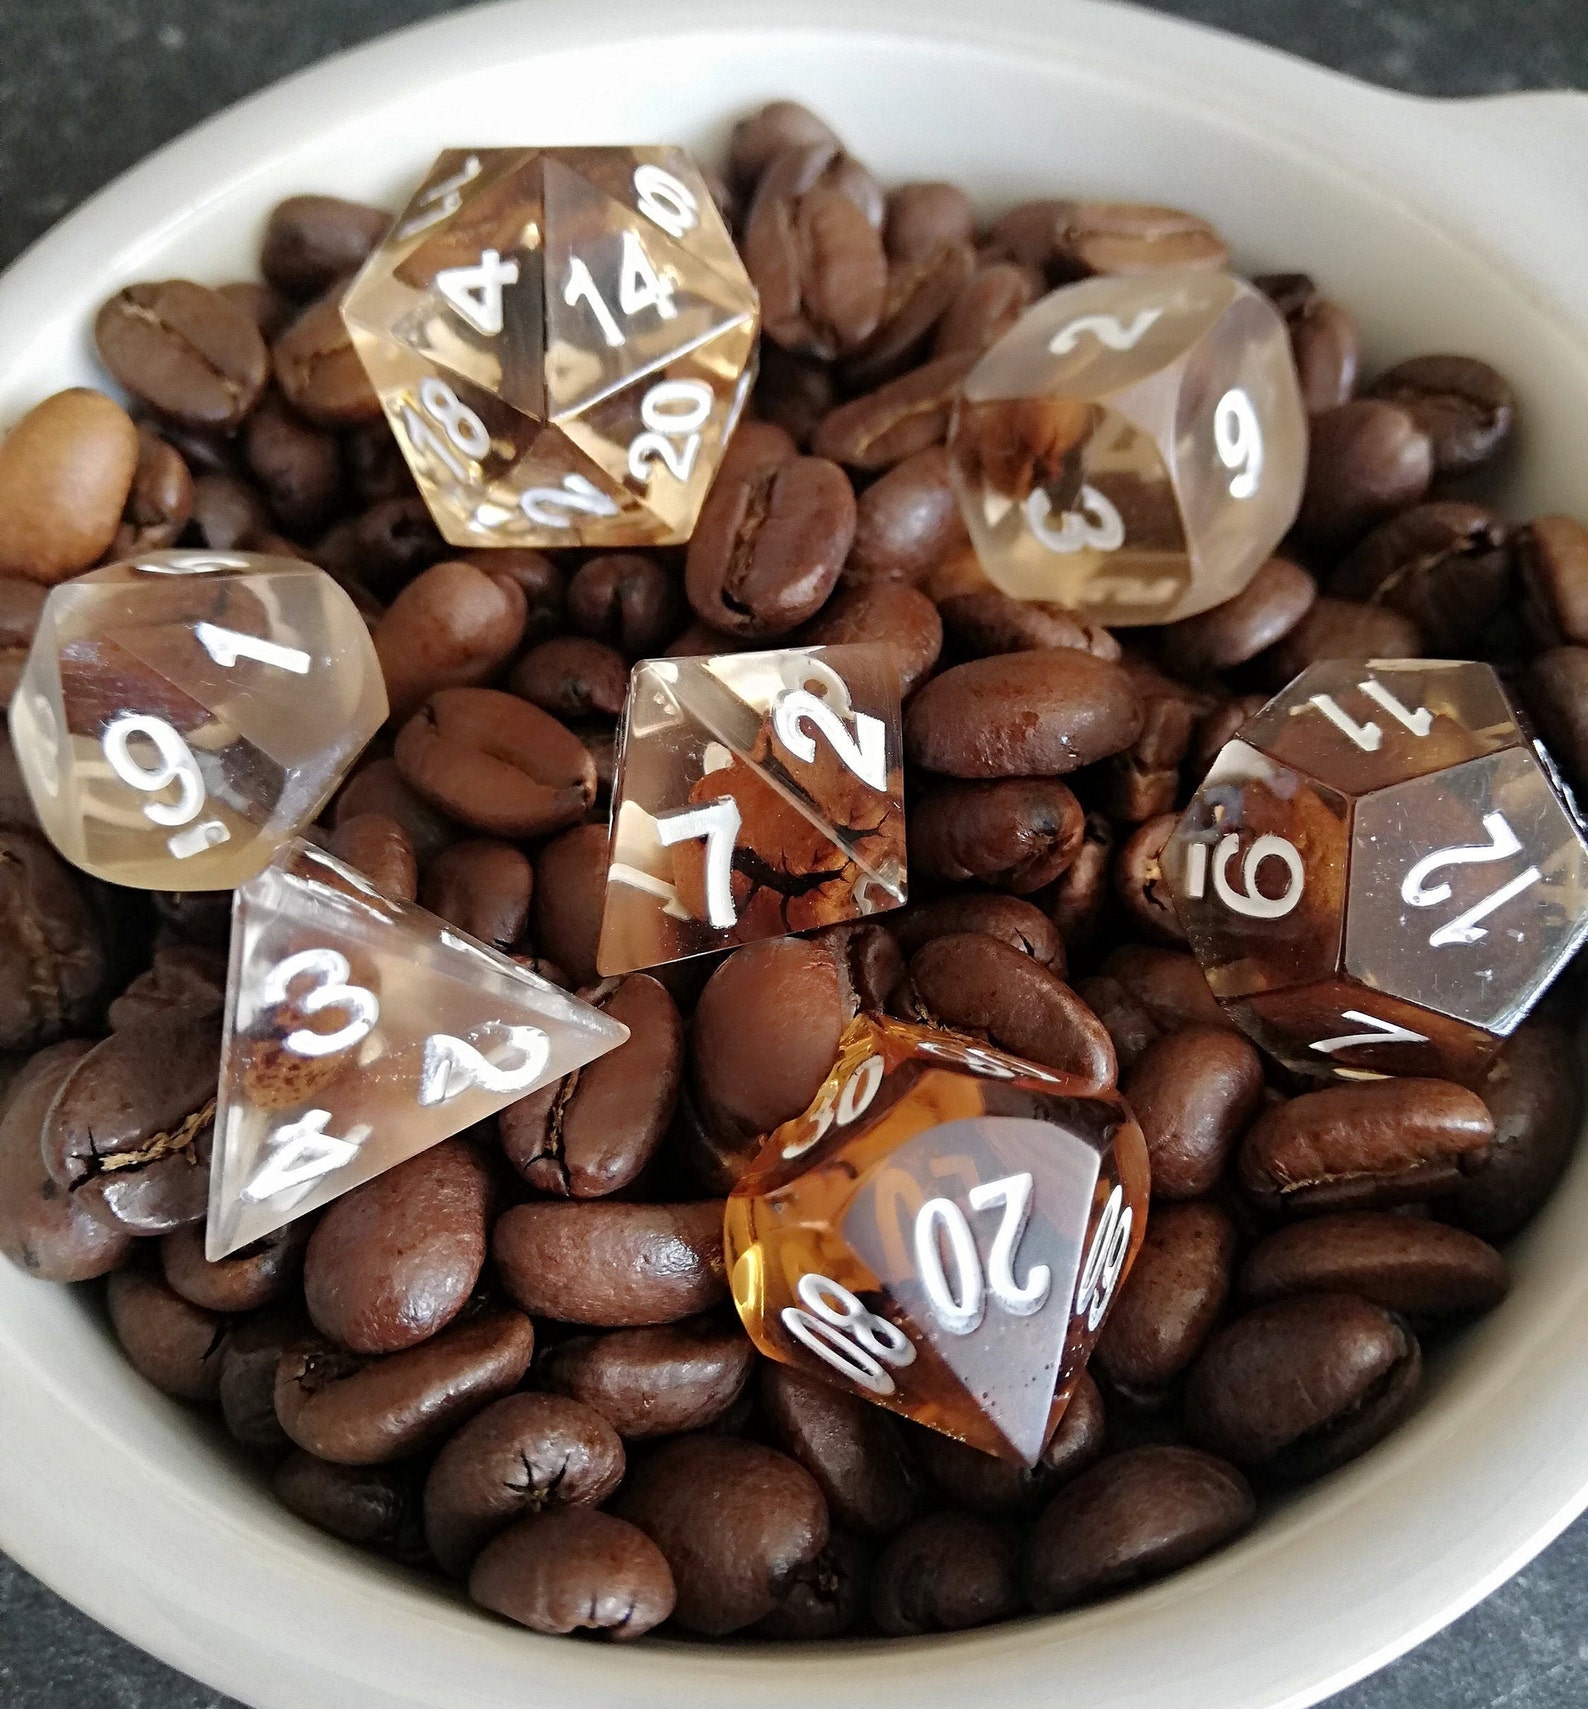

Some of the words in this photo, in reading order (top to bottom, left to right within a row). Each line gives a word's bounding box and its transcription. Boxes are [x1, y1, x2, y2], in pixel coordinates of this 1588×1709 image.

[436, 249, 519, 336] 4
[564, 231, 678, 346] 14
[1048, 309, 1163, 354] 2
[404, 377, 491, 486] 18
[628, 379, 714, 482] 20
[520, 473, 618, 528] 2
[1027, 485, 1125, 552] 3
[195, 622, 311, 674] 1
[771, 689, 887, 792] 2
[1308, 677, 1433, 751] 11
[656, 795, 742, 929] 7
[1401, 810, 1542, 948] 12
[264, 949, 379, 1057] 3
[418, 1024, 550, 1107] 2
[782, 1054, 885, 1159] 30
[240, 1109, 361, 1202] 4
[915, 1172, 1051, 1335] 20
[781, 1273, 917, 1395] 80
